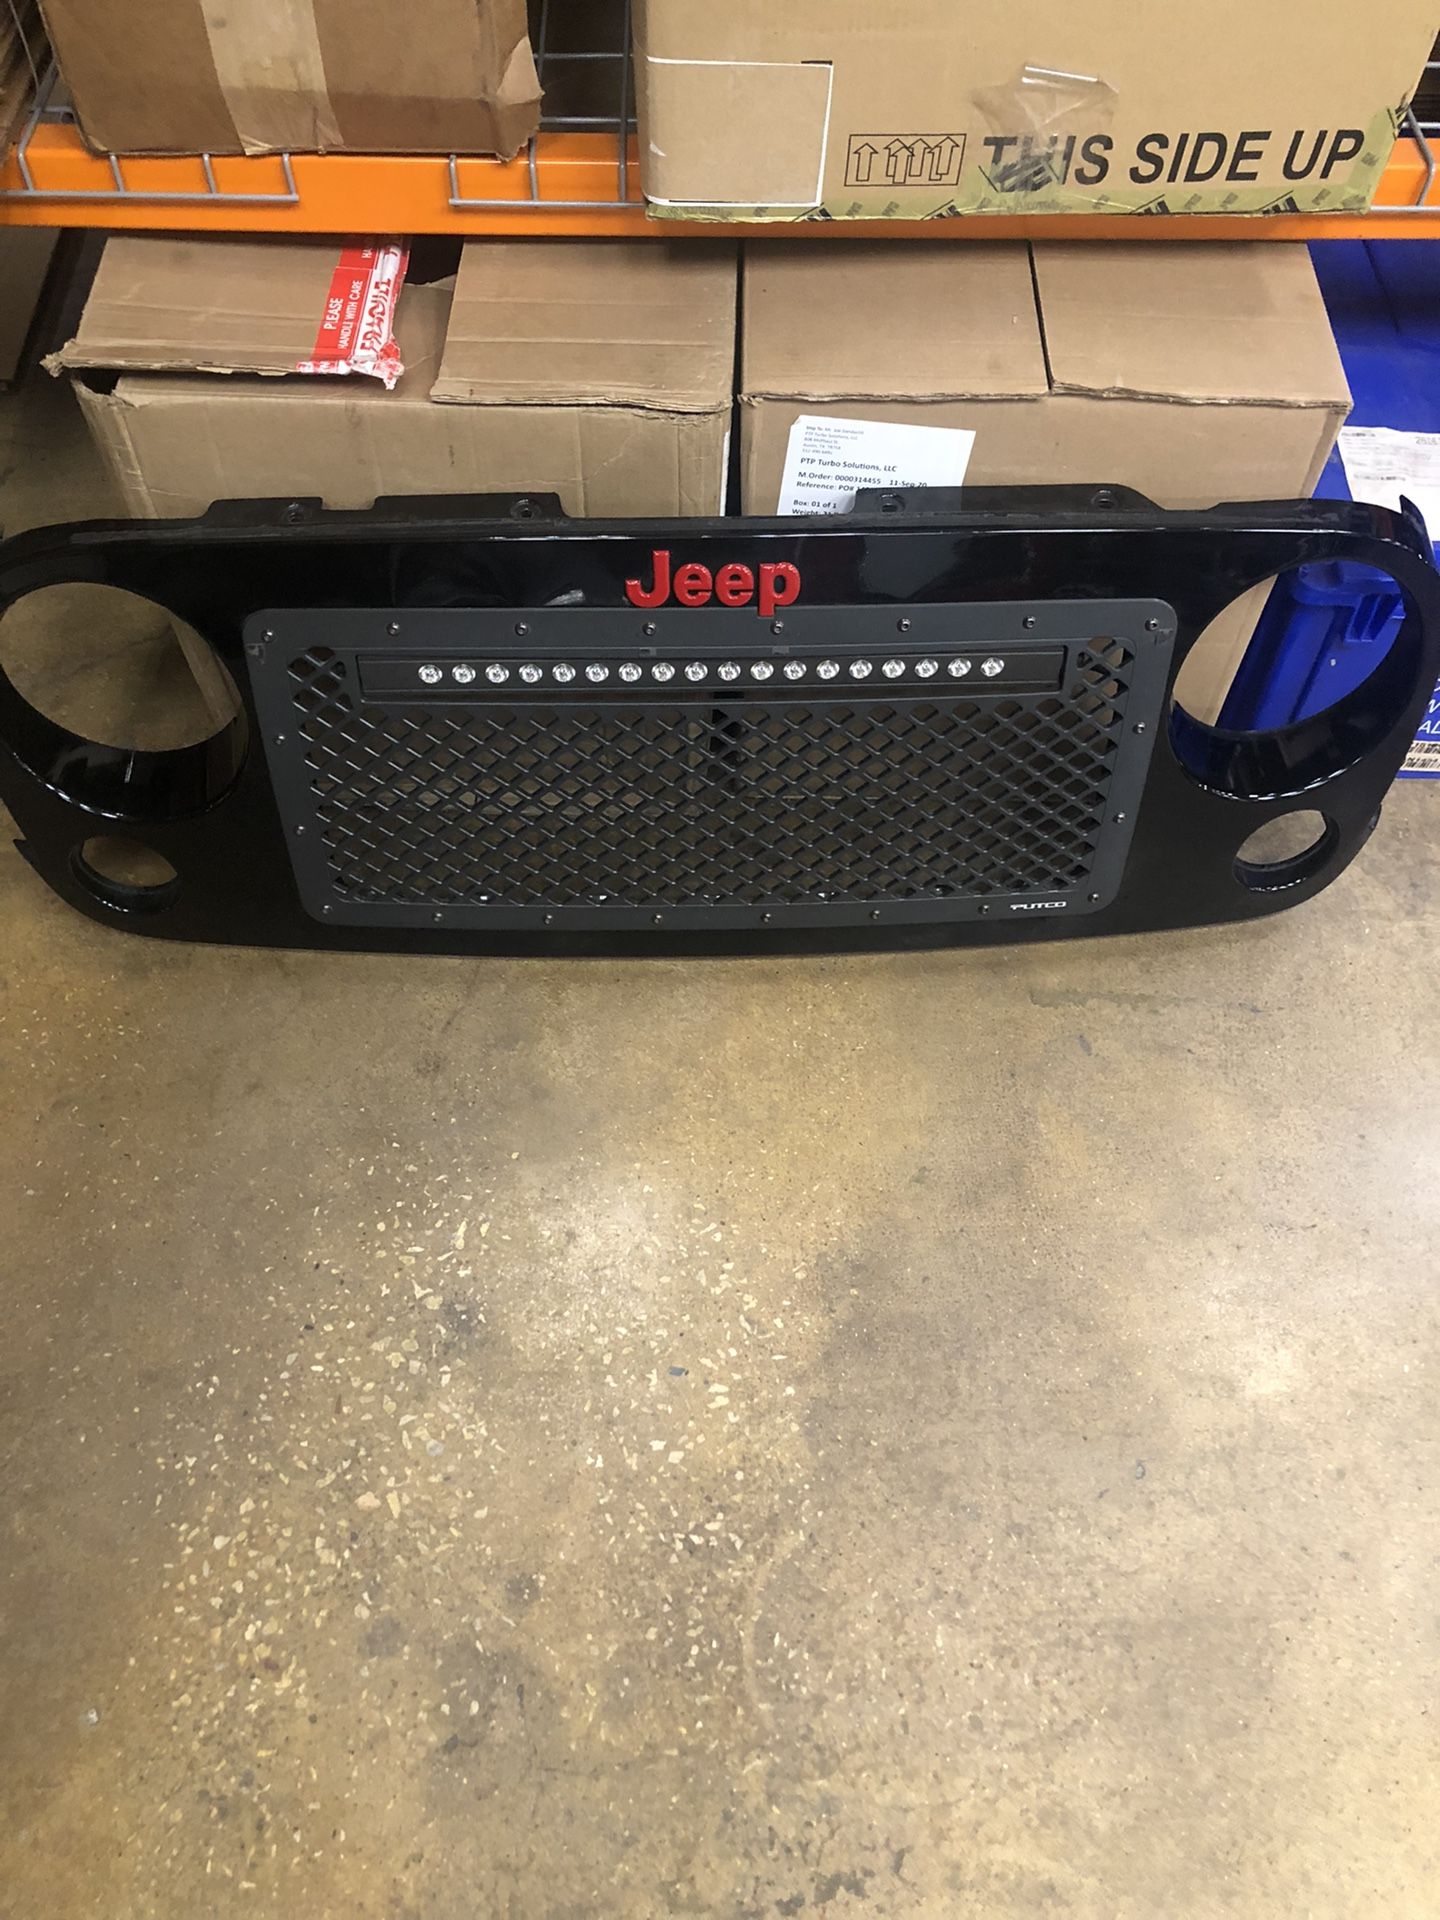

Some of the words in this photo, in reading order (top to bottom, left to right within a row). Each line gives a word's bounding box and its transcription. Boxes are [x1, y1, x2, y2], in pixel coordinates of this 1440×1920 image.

[982, 133, 1114, 186] THIS
[1128, 130, 1273, 185] SIDE
[1281, 128, 1366, 182] UP
[348, 279, 363, 301] CARE
[323, 298, 344, 330] PLEASE
[344, 300, 359, 320] WITH
[800, 457, 817, 466] PTP
[818, 459, 841, 468] Turbo
[843, 461, 881, 473] Solutions,
[883, 465, 898, 473] LLC
[796, 480, 837, 491] Reference:
[838, 484, 855, 492] PO#
[834, 474, 882, 486] 0000314455
[793, 499, 810, 507] Box:
[811, 500, 821, 508] 01
[625, 549, 802, 618] Jeep
